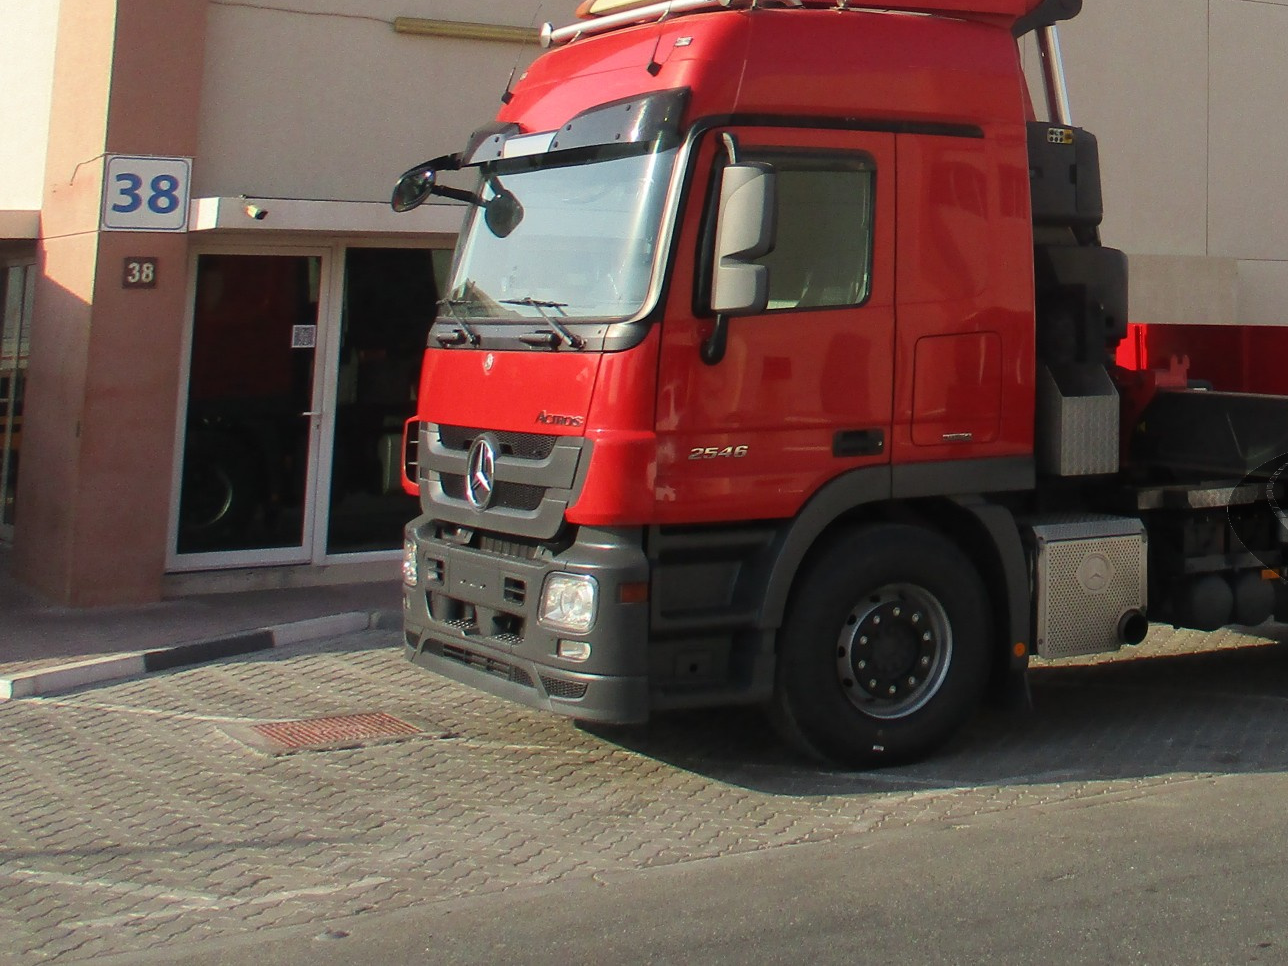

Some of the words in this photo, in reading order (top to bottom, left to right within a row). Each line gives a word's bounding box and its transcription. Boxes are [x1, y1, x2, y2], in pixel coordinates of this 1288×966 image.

[112, 173, 179, 213] 38
[127, 262, 154, 283] 38
[688, 445, 749, 460] 2546
